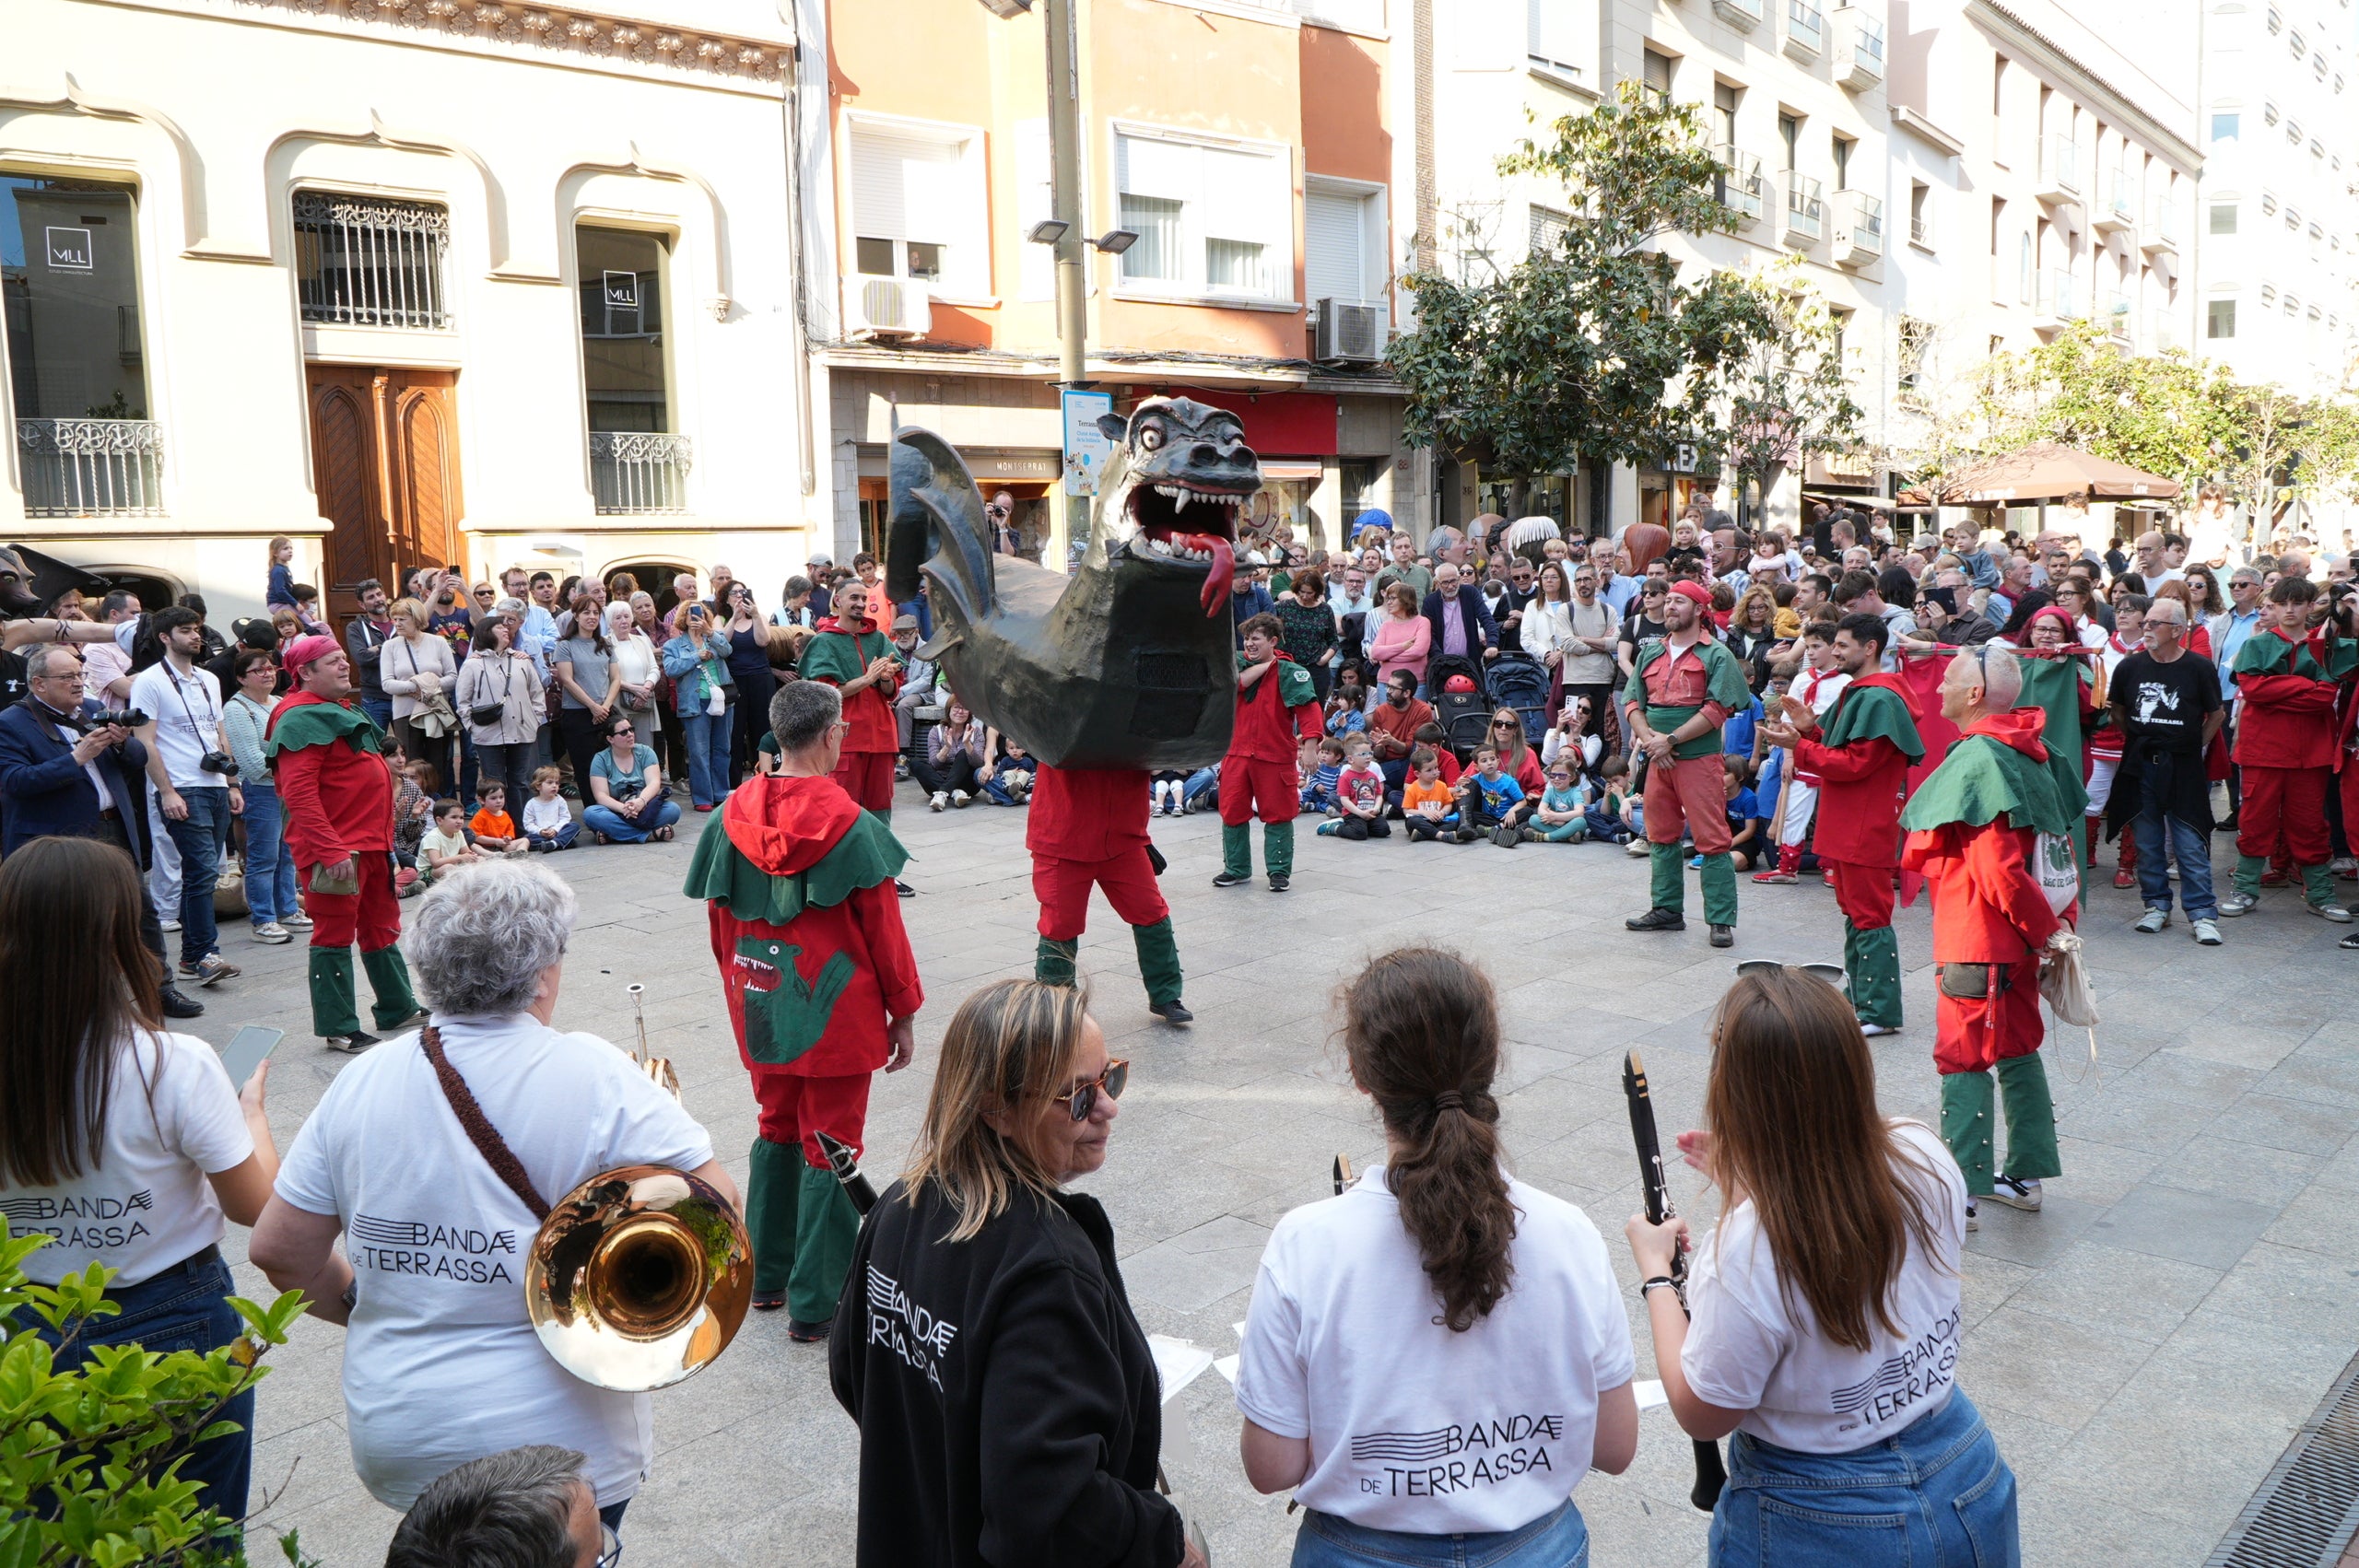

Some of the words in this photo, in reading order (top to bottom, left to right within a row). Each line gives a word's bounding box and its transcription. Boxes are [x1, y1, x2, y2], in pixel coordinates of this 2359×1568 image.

[996, 462, 1047, 472] MONTSERRAT
[352, 1252, 364, 1268] DE
[362, 1246, 513, 1284] TERRASSA
[1360, 1478, 1382, 1495] DE
[1383, 1445, 1553, 1497] TERRASSA
